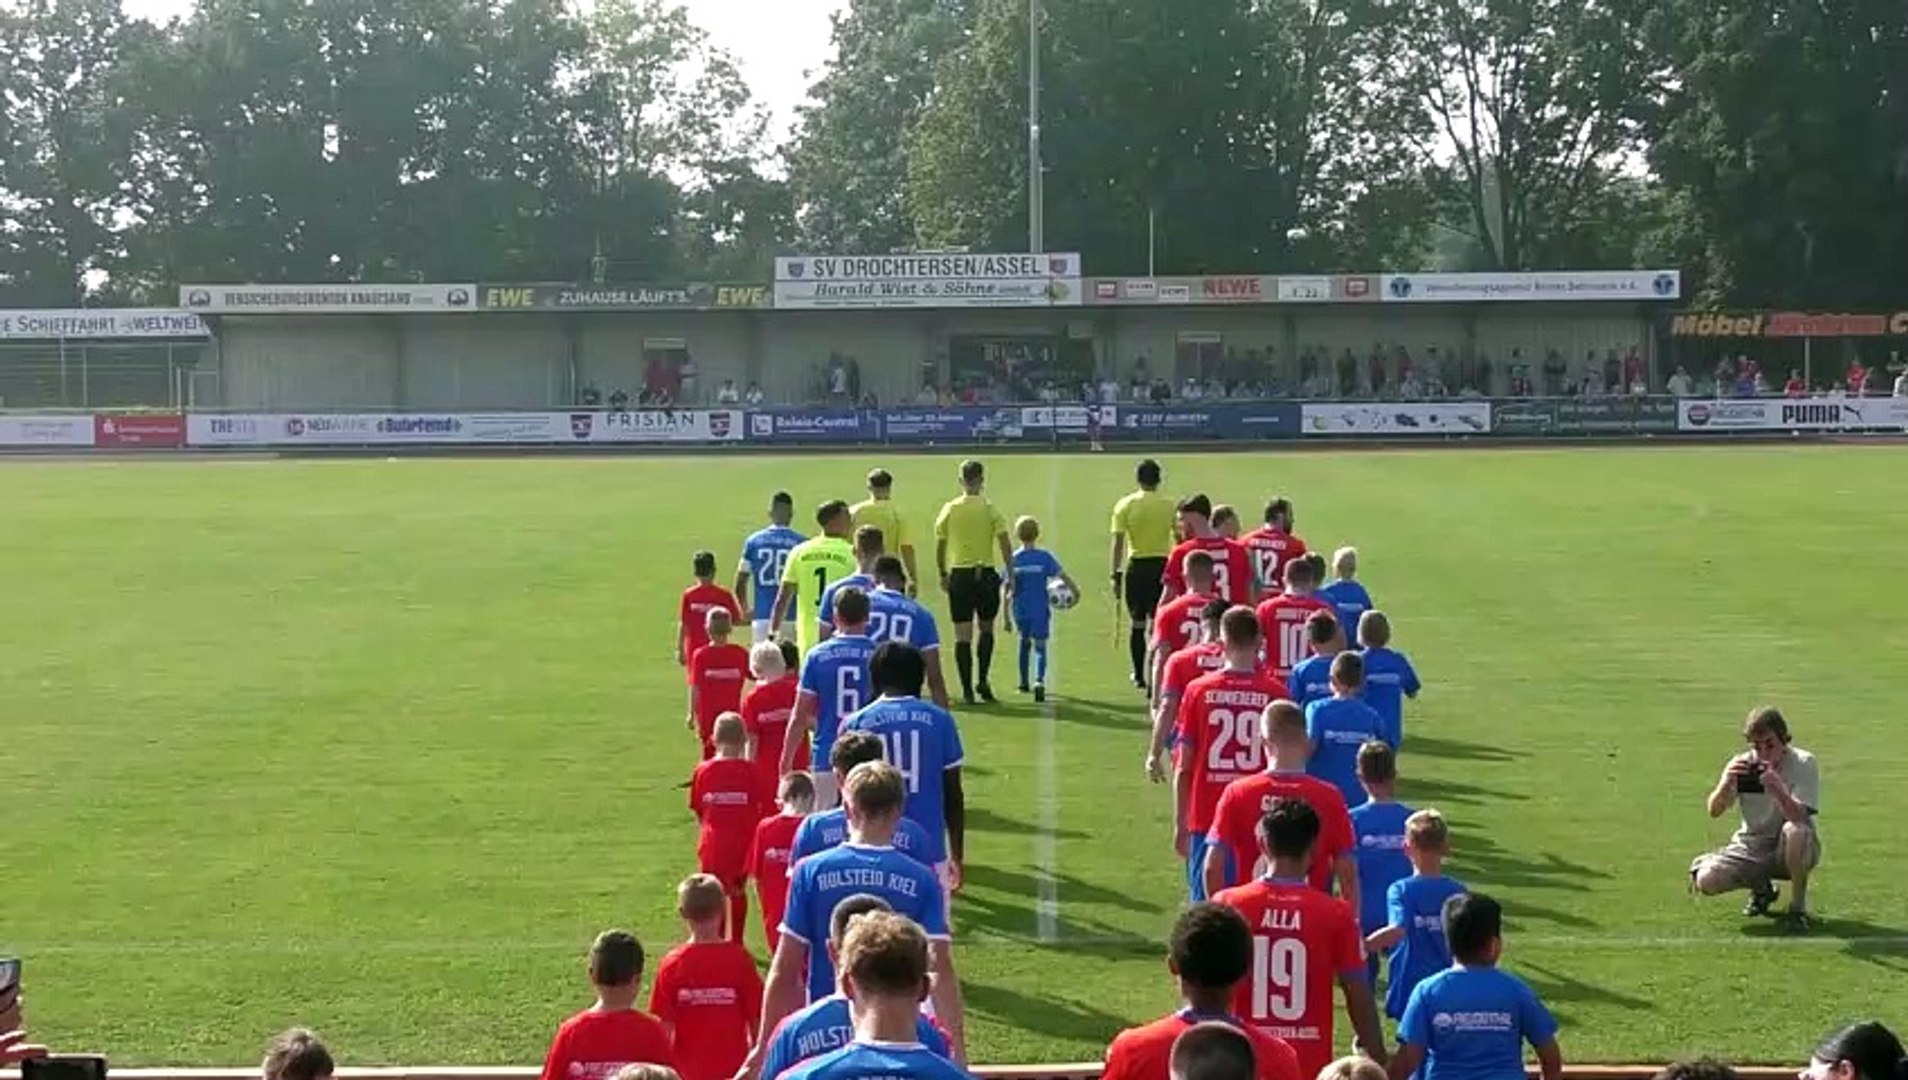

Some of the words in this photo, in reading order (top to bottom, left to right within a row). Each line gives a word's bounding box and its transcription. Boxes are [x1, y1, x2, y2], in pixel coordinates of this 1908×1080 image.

[814, 259, 836, 277] SV
[842, 256, 1042, 276] DROCHTERSEN/ASSEL
[486, 289, 534, 307] EWE
[717, 288, 765, 306] EWE
[1203, 279, 1261, 295] REWE
[1672, 314, 1762, 336] Möbel
[606, 412, 695, 427] FRISIAN
[1782, 405, 1840, 424] PUMA
[1255, 549, 1280, 586] 12
[813, 566, 827, 607] 1
[1179, 620, 1203, 645] 2
[1279, 620, 1310, 668] 10
[836, 665, 861, 718] 6
[1208, 708, 1262, 771] 29
[816, 867, 884, 892] HOLSTEIN
[888, 872, 919, 898] KIEL
[1260, 909, 1301, 931] ALLA
[1251, 934, 1307, 1021] 19
[797, 1025, 854, 1057] HOLST
